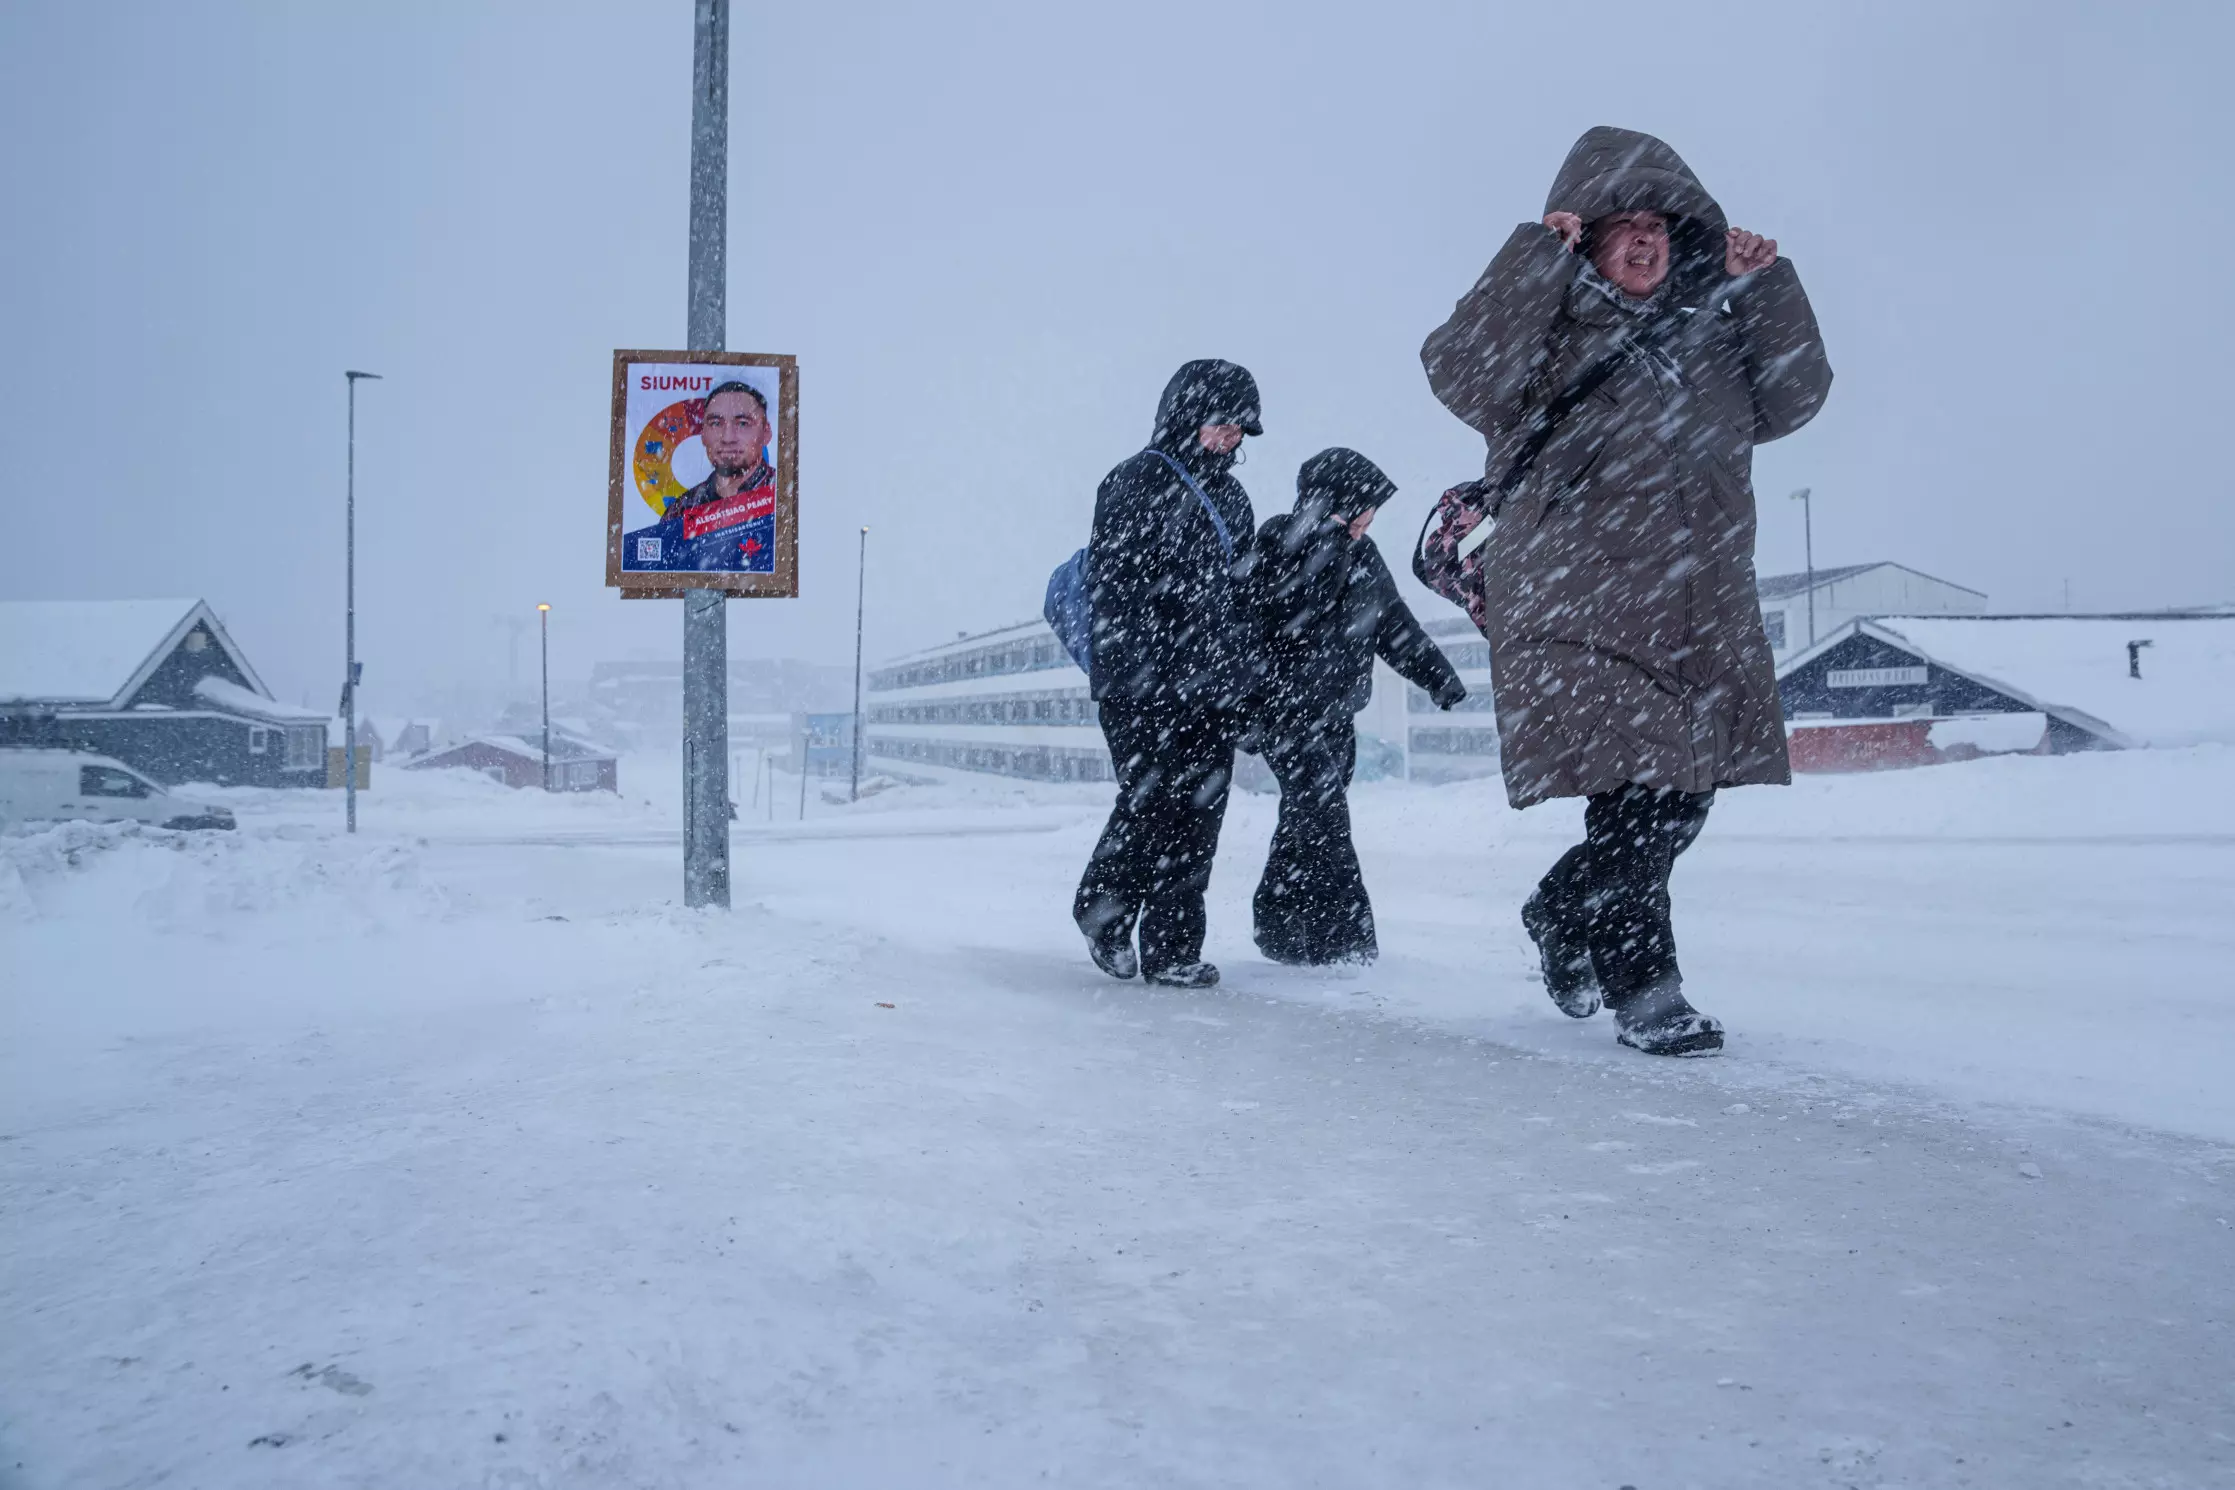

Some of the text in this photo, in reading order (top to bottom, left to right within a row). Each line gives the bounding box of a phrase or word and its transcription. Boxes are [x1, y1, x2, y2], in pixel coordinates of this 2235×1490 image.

[641, 376, 713, 391] SIUMUT
[695, 497, 772, 525] ALEQATSIAQ PEARY
